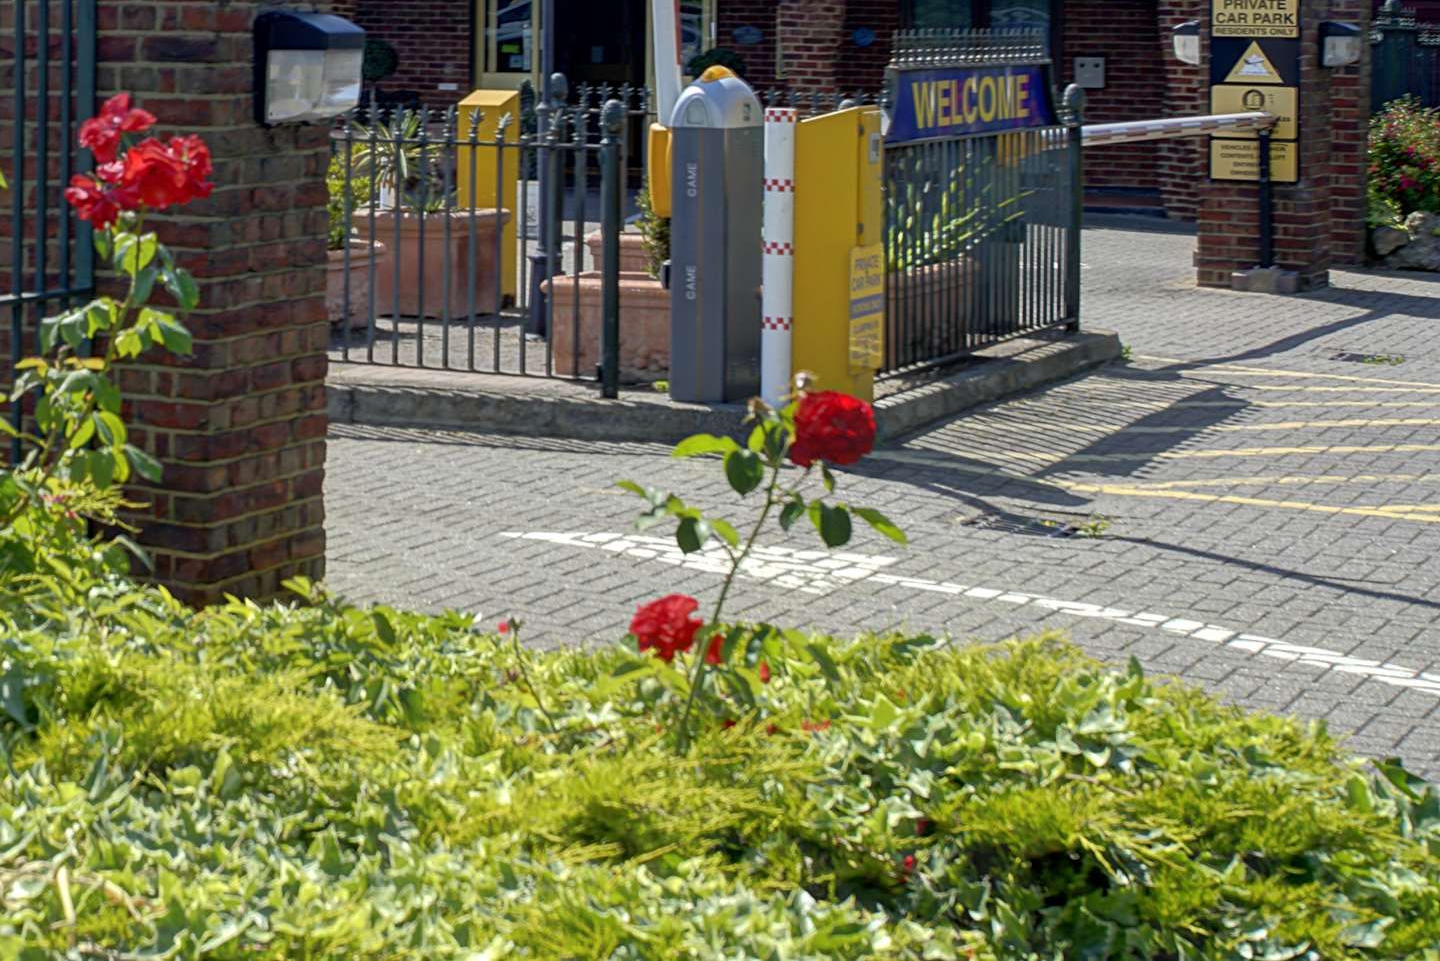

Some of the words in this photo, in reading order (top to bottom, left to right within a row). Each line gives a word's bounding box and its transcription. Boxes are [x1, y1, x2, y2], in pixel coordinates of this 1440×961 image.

[1215, 12, 1248, 24] CAR
[1252, 12, 1294, 24] PARK
[1215, 27, 1267, 35] RESIDENTS
[1269, 27, 1294, 36] ONLY
[912, 74, 1030, 129] WELCOME
